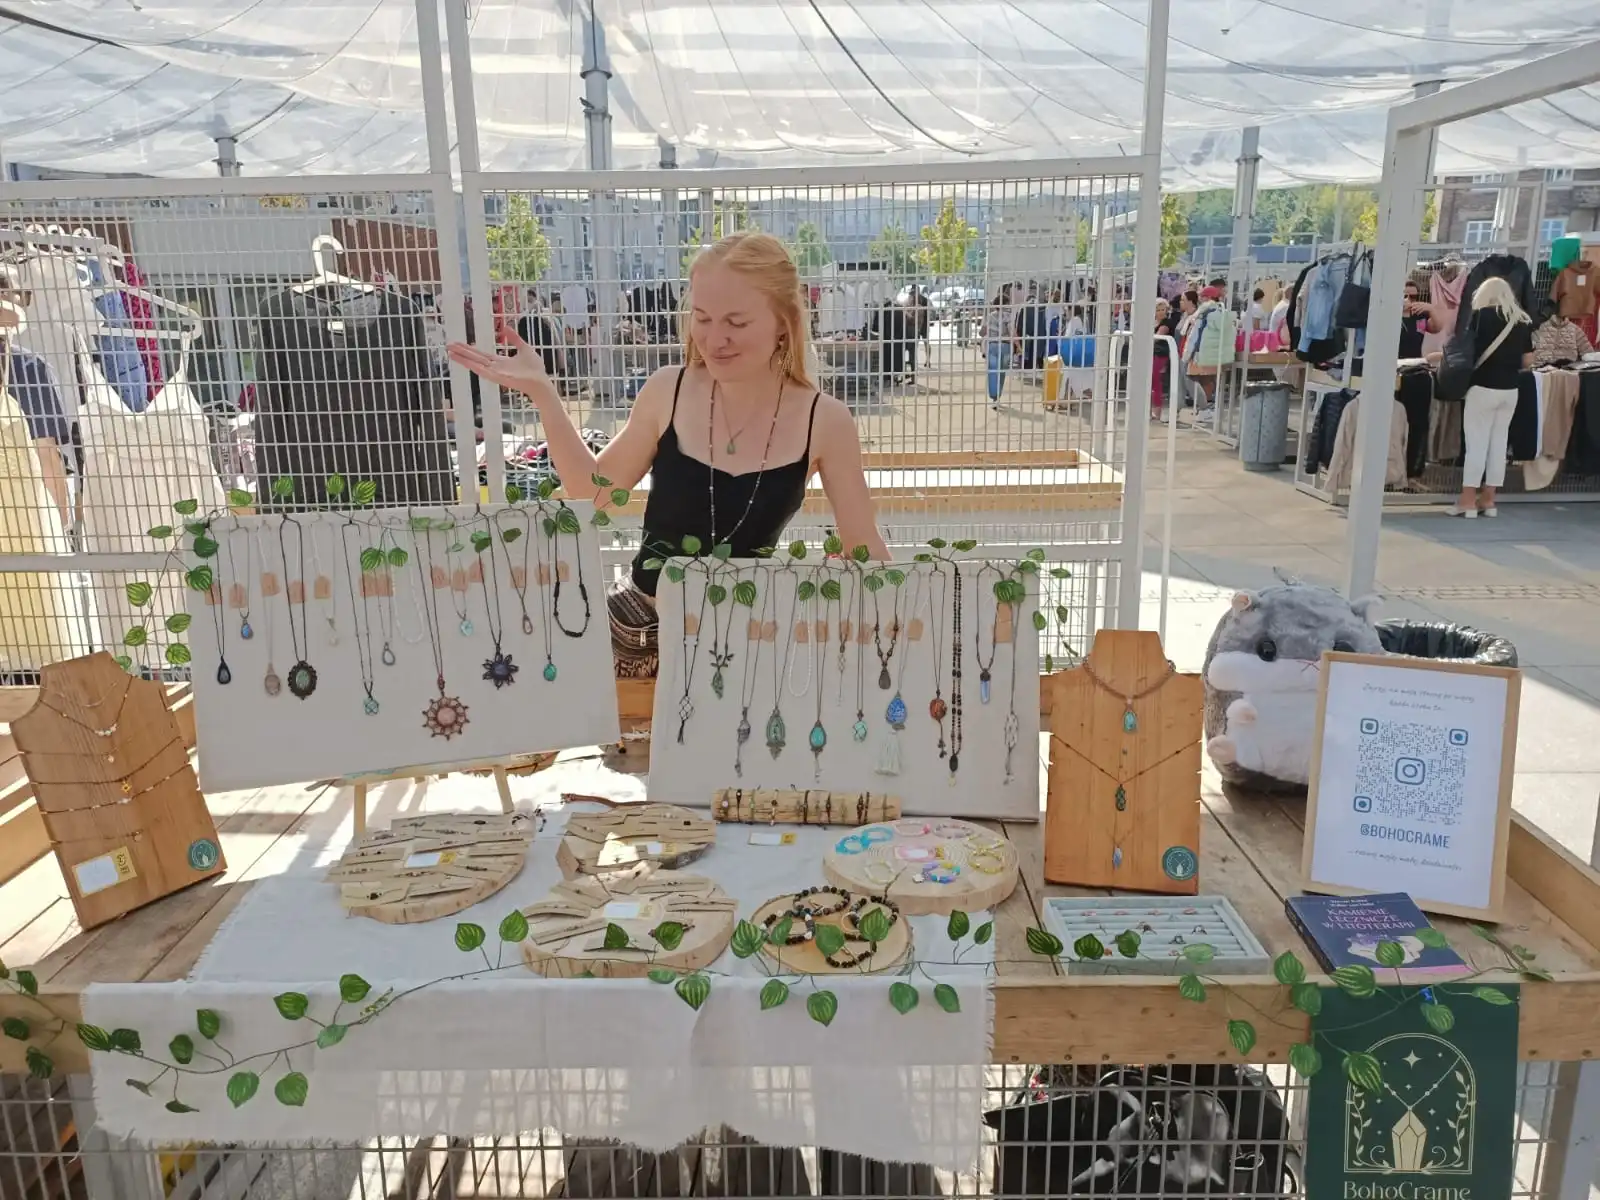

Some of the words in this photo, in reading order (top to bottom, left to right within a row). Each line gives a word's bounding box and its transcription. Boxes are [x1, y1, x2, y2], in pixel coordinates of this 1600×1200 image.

[1360, 823, 1451, 849] @BOHOCRAME
[1326, 908, 1390, 916] KAMIENIE
[1327, 914, 1401, 922] LECZNICZE
[1336, 921, 1416, 930] LITOTERAPII
[1343, 1180, 1472, 1200] BohoCrame
